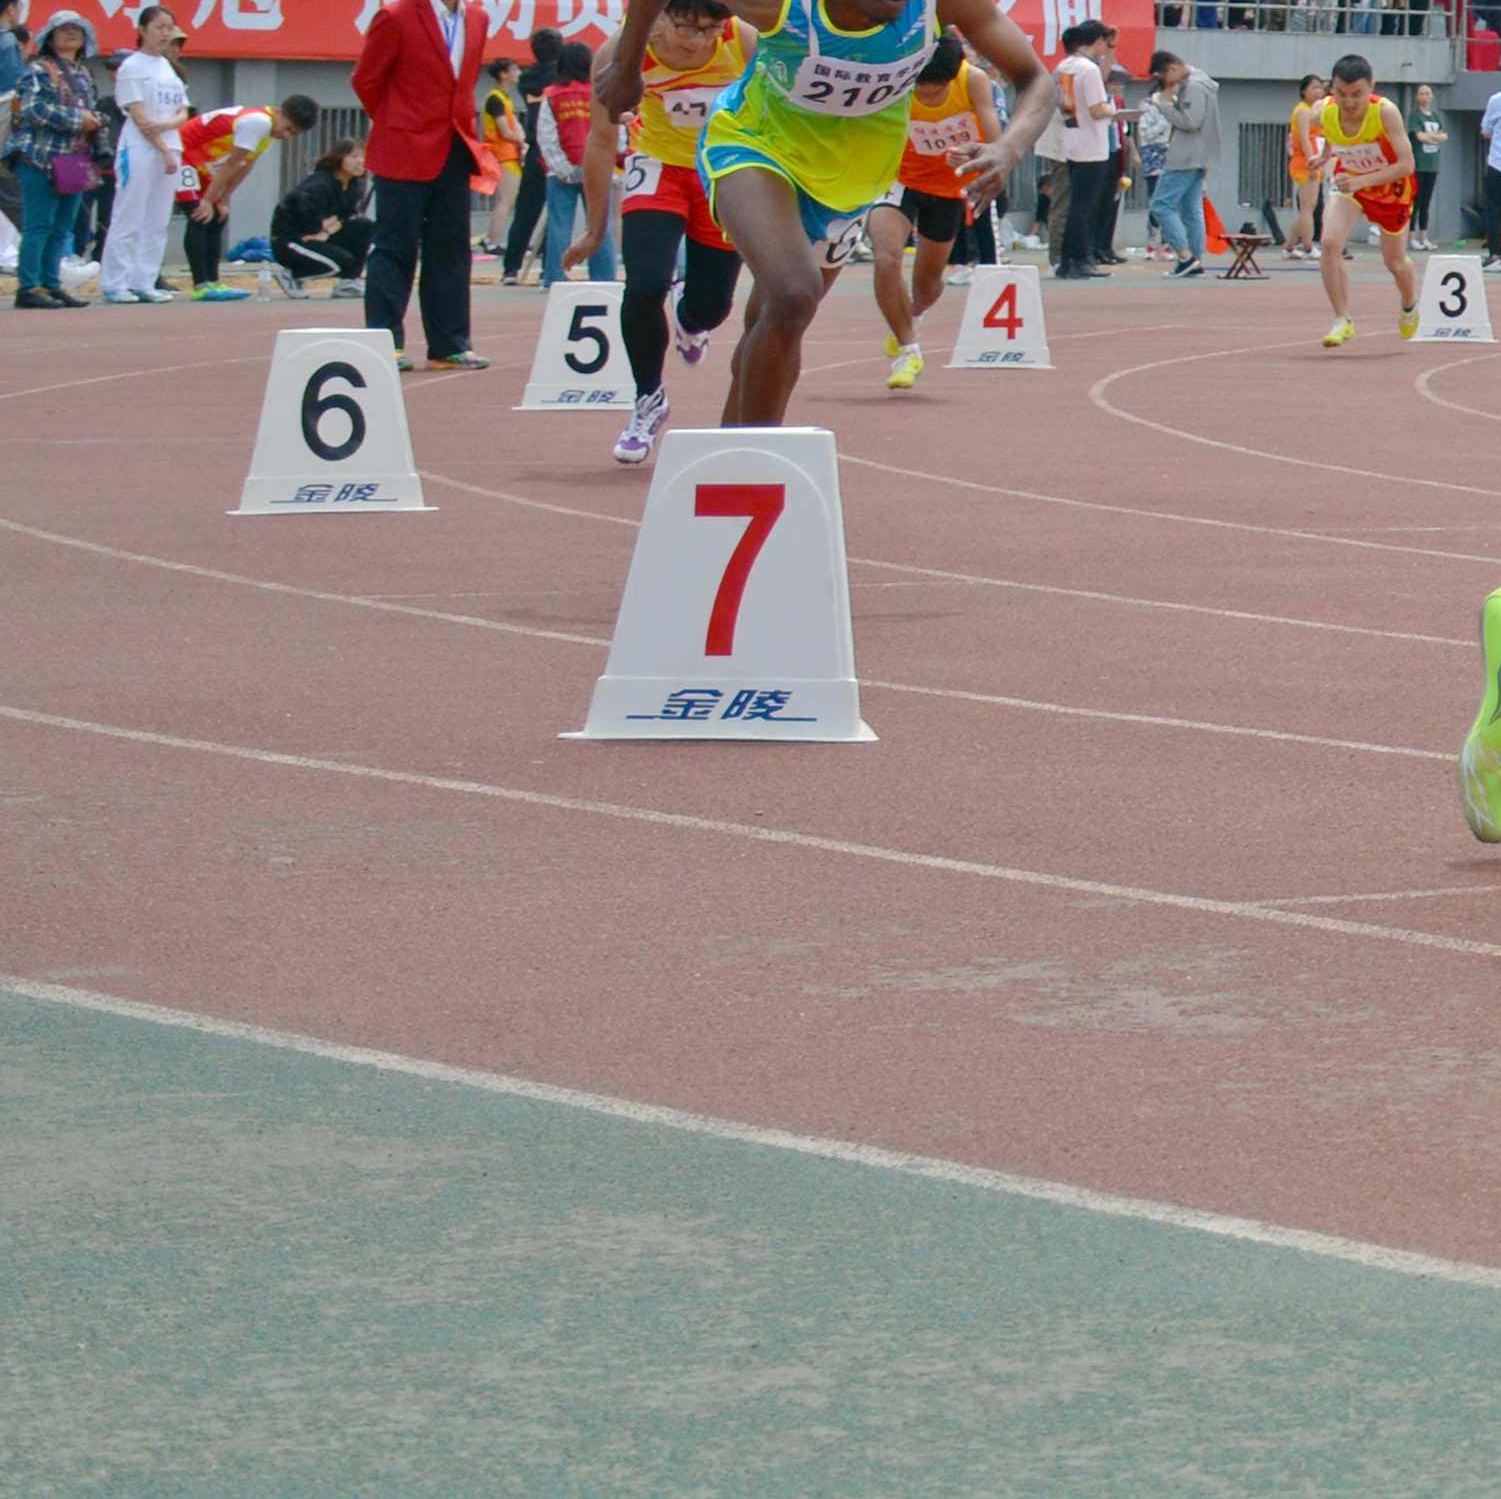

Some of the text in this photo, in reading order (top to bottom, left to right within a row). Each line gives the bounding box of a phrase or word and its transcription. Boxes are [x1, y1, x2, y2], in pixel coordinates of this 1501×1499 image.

[983, 283, 1024, 340] 4
[1439, 271, 1468, 318] 3
[564, 304, 611, 375] 5
[301, 360, 368, 462] 6
[294, 482, 381, 503] 金陵
[694, 483, 787, 657] 7
[660, 688, 793, 722] 金陵
